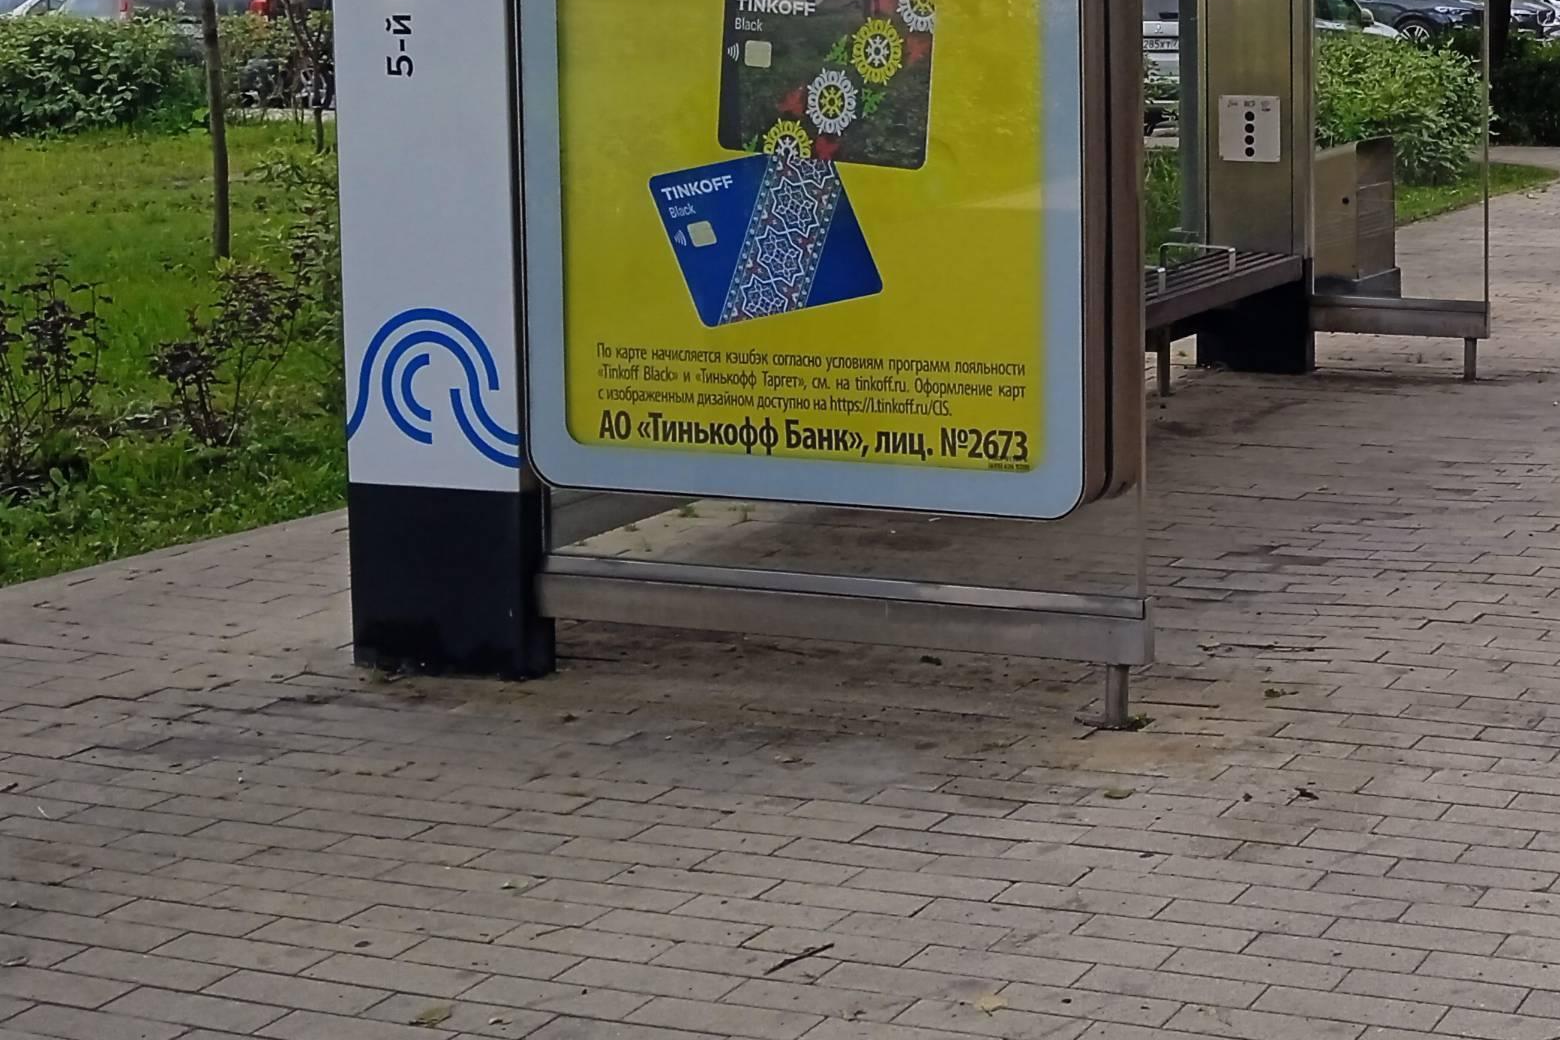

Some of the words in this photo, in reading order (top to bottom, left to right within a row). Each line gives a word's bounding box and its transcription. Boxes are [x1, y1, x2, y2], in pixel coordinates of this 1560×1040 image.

[734, 16, 763, 32] Black
[385, 14, 414, 77] 5-й
[660, 174, 734, 201] TINKOFF
[668, 203, 696, 219] Black
[597, 342, 611, 358] По
[616, 346, 647, 362] карте
[651, 347, 721, 364] начисляется
[726, 349, 768, 365] кэшбэк
[772, 352, 822, 368] согласно
[826, 356, 884, 372] условиям
[888, 359, 950, 377] программ
[954, 361, 1026, 377] лояльности
[598, 389, 604, 400] с
[606, 386, 694, 405] изображенным
[697, 391, 754, 407] дизайном
[757, 395, 810, 412] доступно
[813, 399, 827, 411] на
[683, 371, 691, 383] и
[812, 378, 831, 390] см.
[836, 378, 850, 390] на
[914, 378, 993, 397] Оформление
[998, 385, 1026, 401] карт
[599, 409, 632, 440] АО
[637, 411, 779, 456] «Тинькофф
[785, 418, 869, 457] Банк»,
[875, 430, 933, 461] лиц.
[940, 426, 1029, 462] №2673
